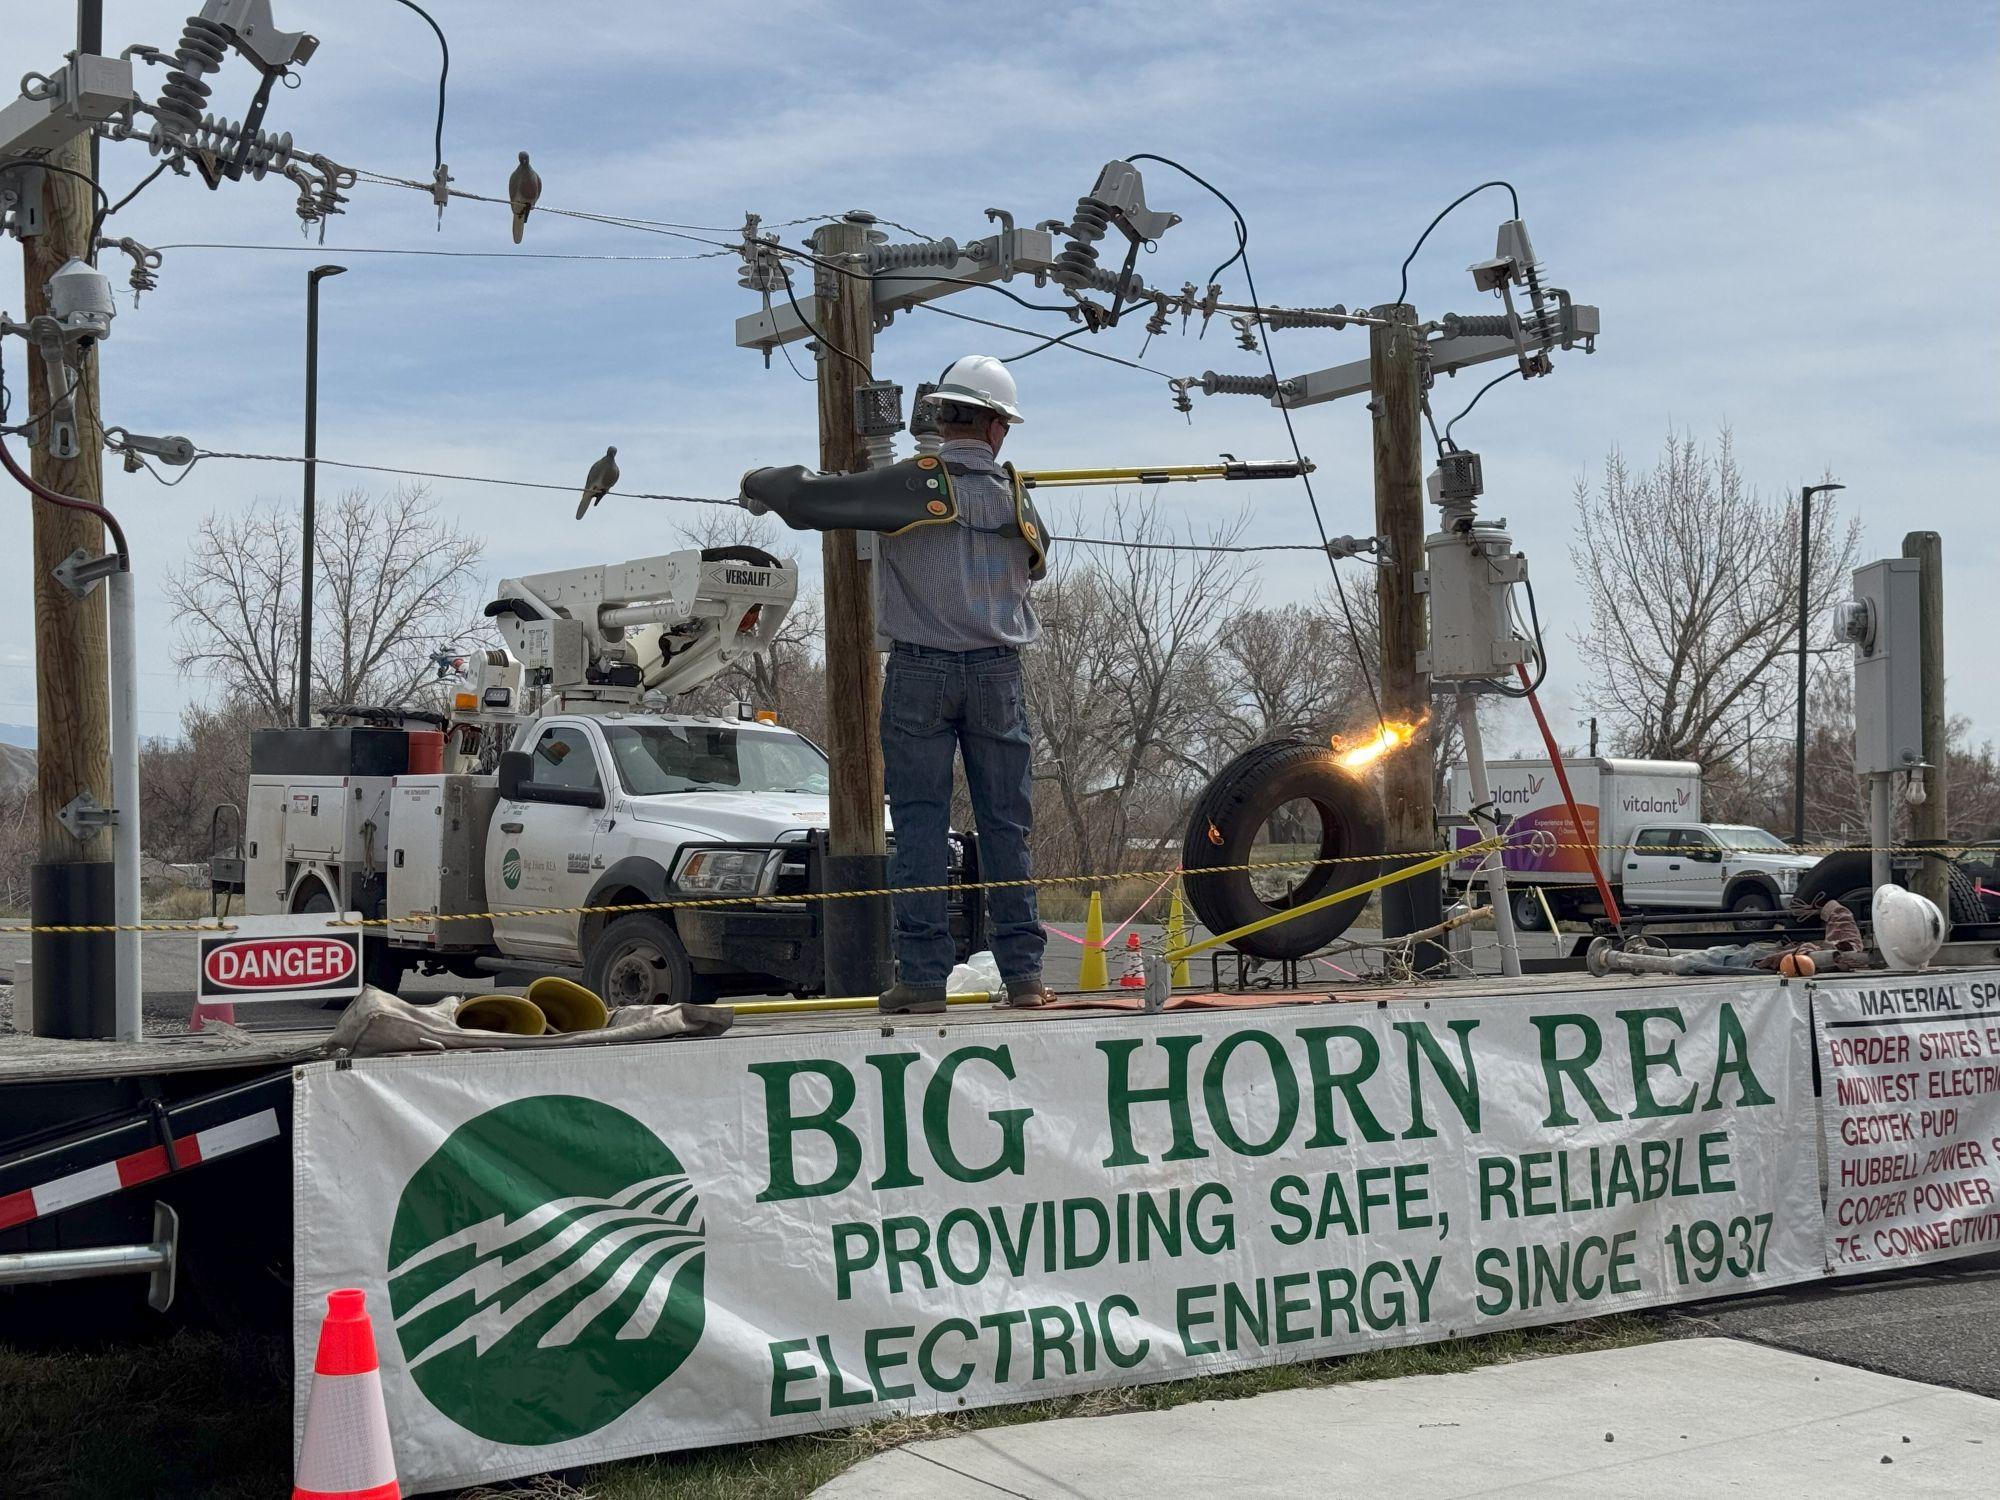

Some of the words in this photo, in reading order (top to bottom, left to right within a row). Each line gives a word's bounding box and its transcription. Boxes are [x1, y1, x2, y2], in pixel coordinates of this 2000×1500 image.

[725, 569, 771, 587] VERSALIFT
[1469, 785, 1530, 804] valant
[1623, 795, 1679, 813] vitalant
[218, 946, 344, 980] DANGER
[1859, 986, 1962, 1016] MATERIAL
[1970, 983, 2000, 1009] SP
[1830, 1035, 1910, 1067] BORDER
[1919, 1029, 1982, 1061] STATES
[1986, 1027, 2000, 1055] E
[747, 1043, 1035, 1203] BIG
[1095, 1019, 1480, 1168] HORN
[1529, 1002, 1775, 1128] REA
[1837, 1073, 1919, 1107] MIDWEST
[1928, 1066, 2000, 1099] ELECTRI
[1840, 1112, 1915, 1146] GEOTEK
[1920, 1108, 1958, 1138] PUPI
[1841, 1152, 1919, 1188] HUBBELL
[1922, 1141, 1988, 1176] POWER
[831, 1181, 1236, 1301] PROVIDING
[1269, 1162, 1449, 1246] SAFE,
[1478, 1131, 1737, 1222] RELIABLE
[1838, 1190, 1907, 1227] COOPER
[1913, 1178, 1995, 1214] POWER
[1835, 1234, 1870, 1264] T.E.
[768, 1293, 1150, 1417] ELECTRIC
[1176, 1255, 1443, 1358] ENERGY
[1475, 1230, 1642, 1316] SINCE
[1665, 1212, 1774, 1286] 1937
